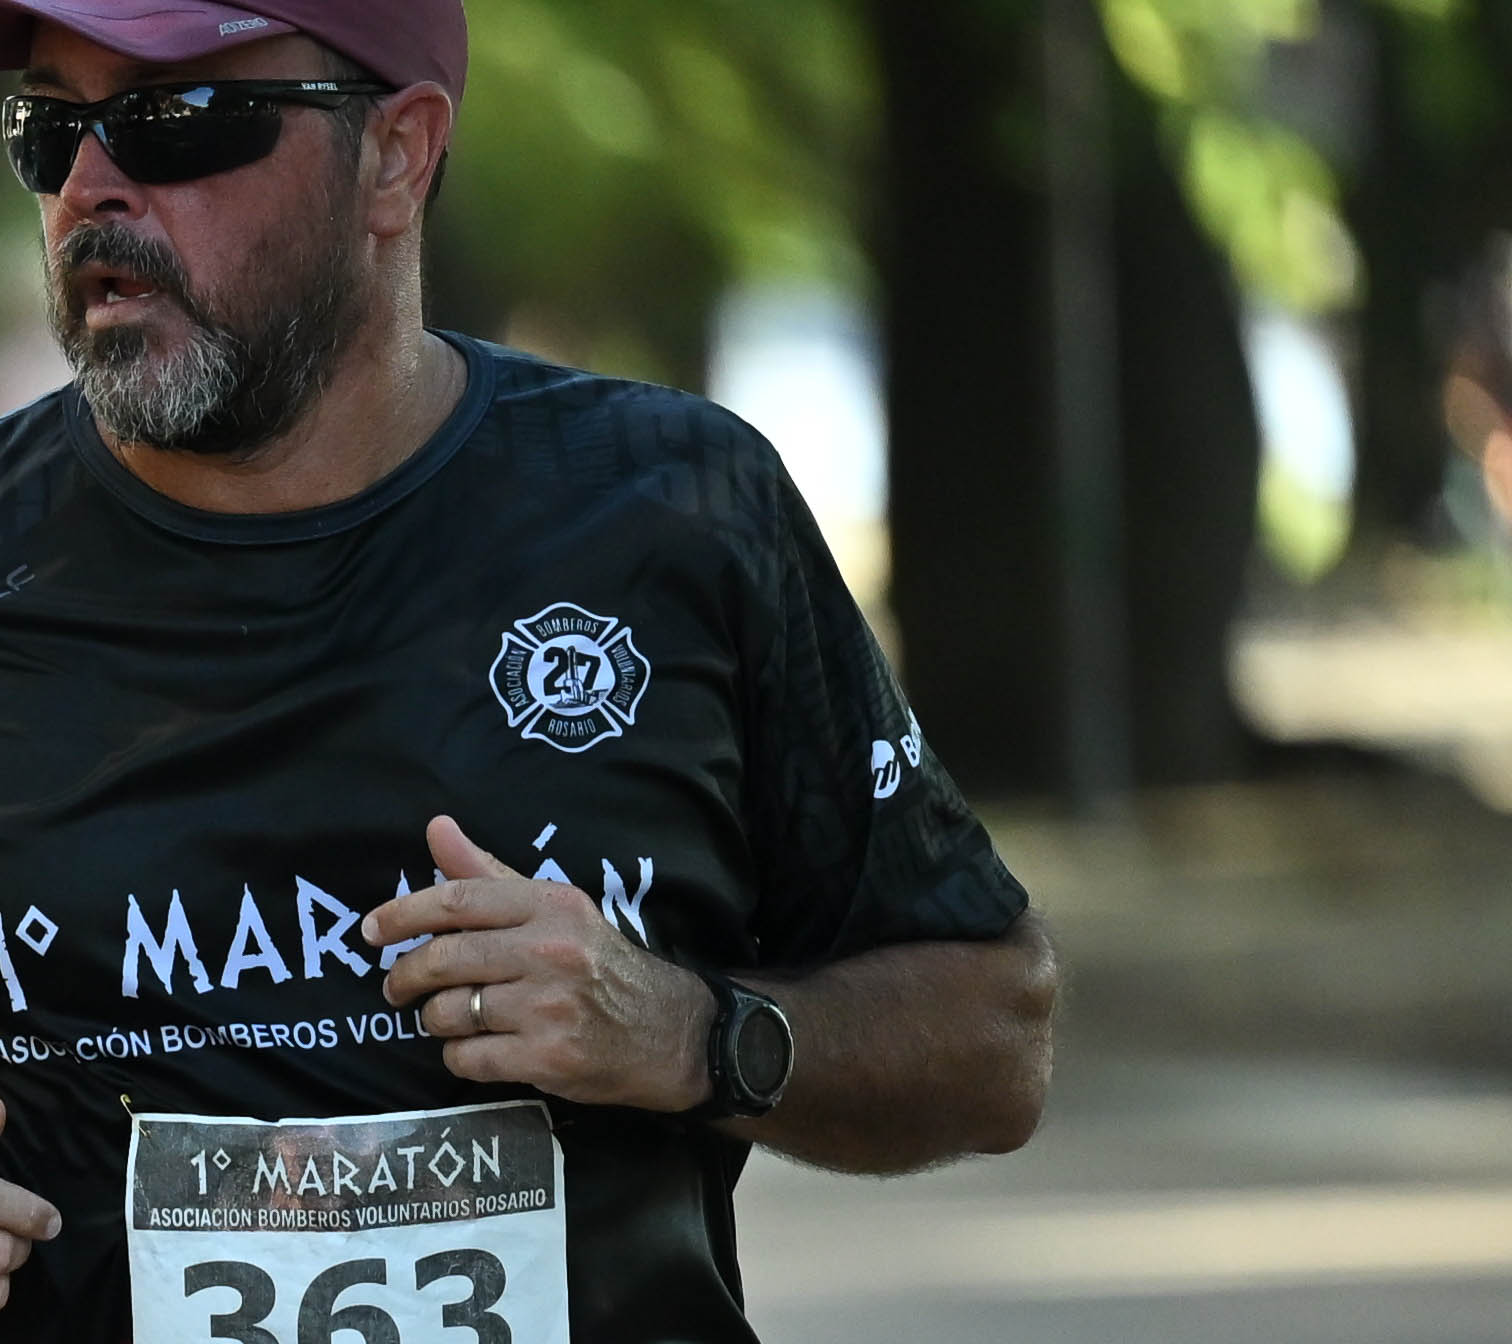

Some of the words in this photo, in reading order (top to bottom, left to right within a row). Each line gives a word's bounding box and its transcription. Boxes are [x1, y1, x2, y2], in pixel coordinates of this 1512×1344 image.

[536, 618, 598, 637] BOMBEROS
[548, 718, 597, 737] ROSARIO
[160, 1017, 339, 1054] BOMBEROS
[251, 1126, 501, 1197] MARATÓN
[258, 1208, 351, 1229] BOMBEROS
[355, 1200, 471, 1227] VOLUNTARIOS
[475, 1189, 546, 1211] ROSARIO
